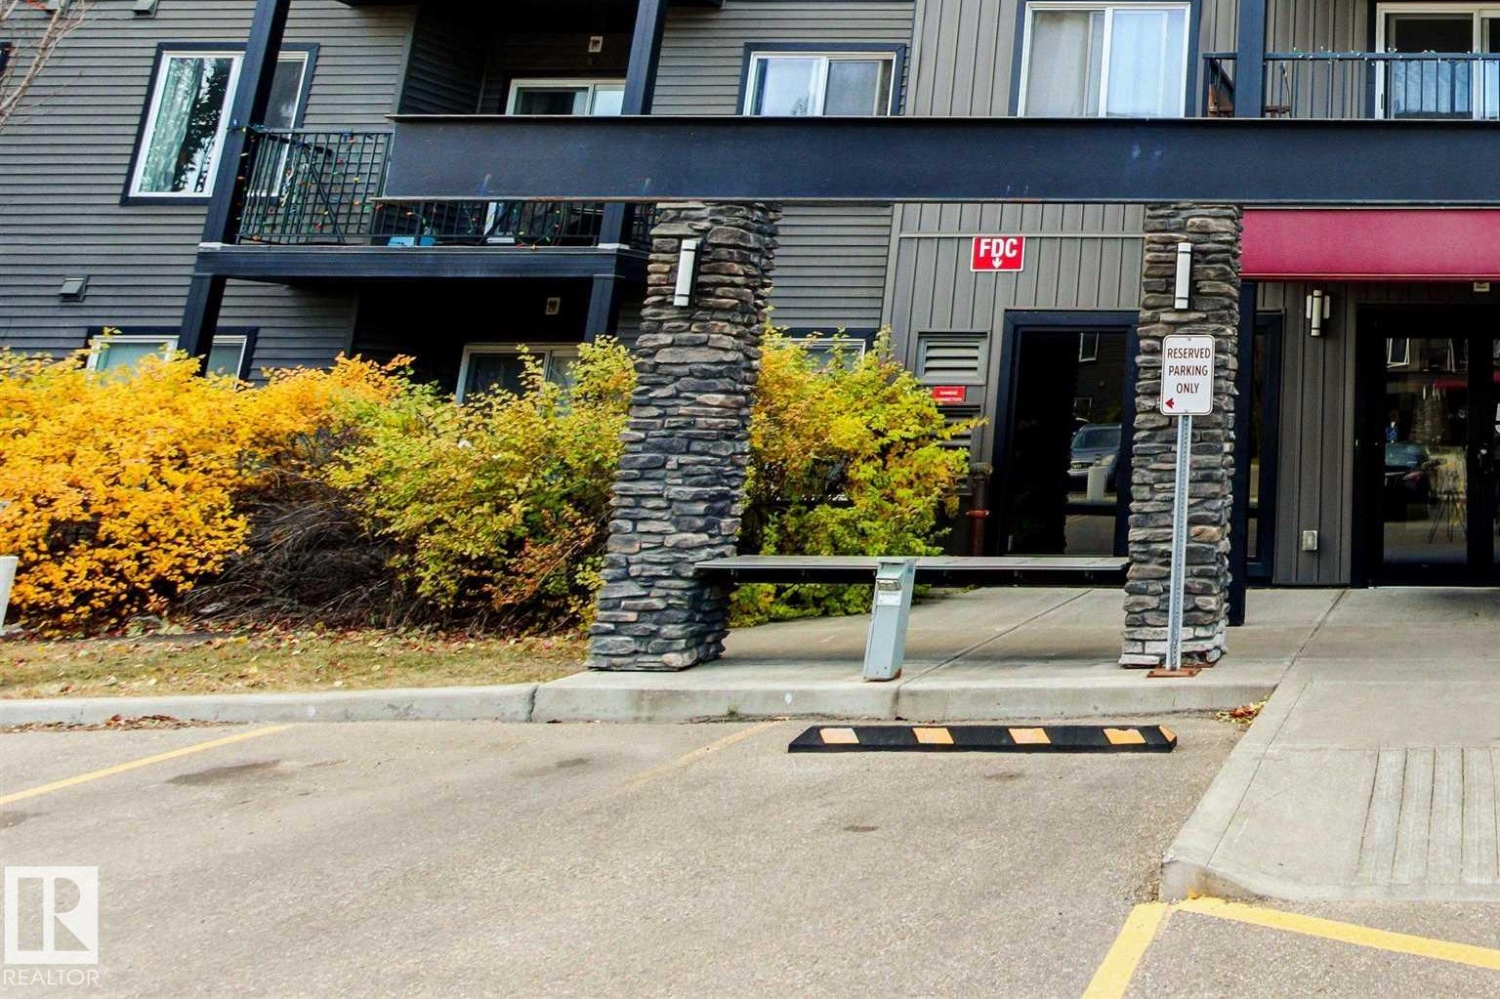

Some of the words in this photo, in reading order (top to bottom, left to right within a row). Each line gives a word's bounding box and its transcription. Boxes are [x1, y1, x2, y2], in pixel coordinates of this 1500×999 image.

[979, 238, 1018, 258] FDC
[1167, 348, 1211, 359] RESERVED
[1168, 365, 1208, 376] PARKING
[1176, 383, 1200, 394] ONLY
